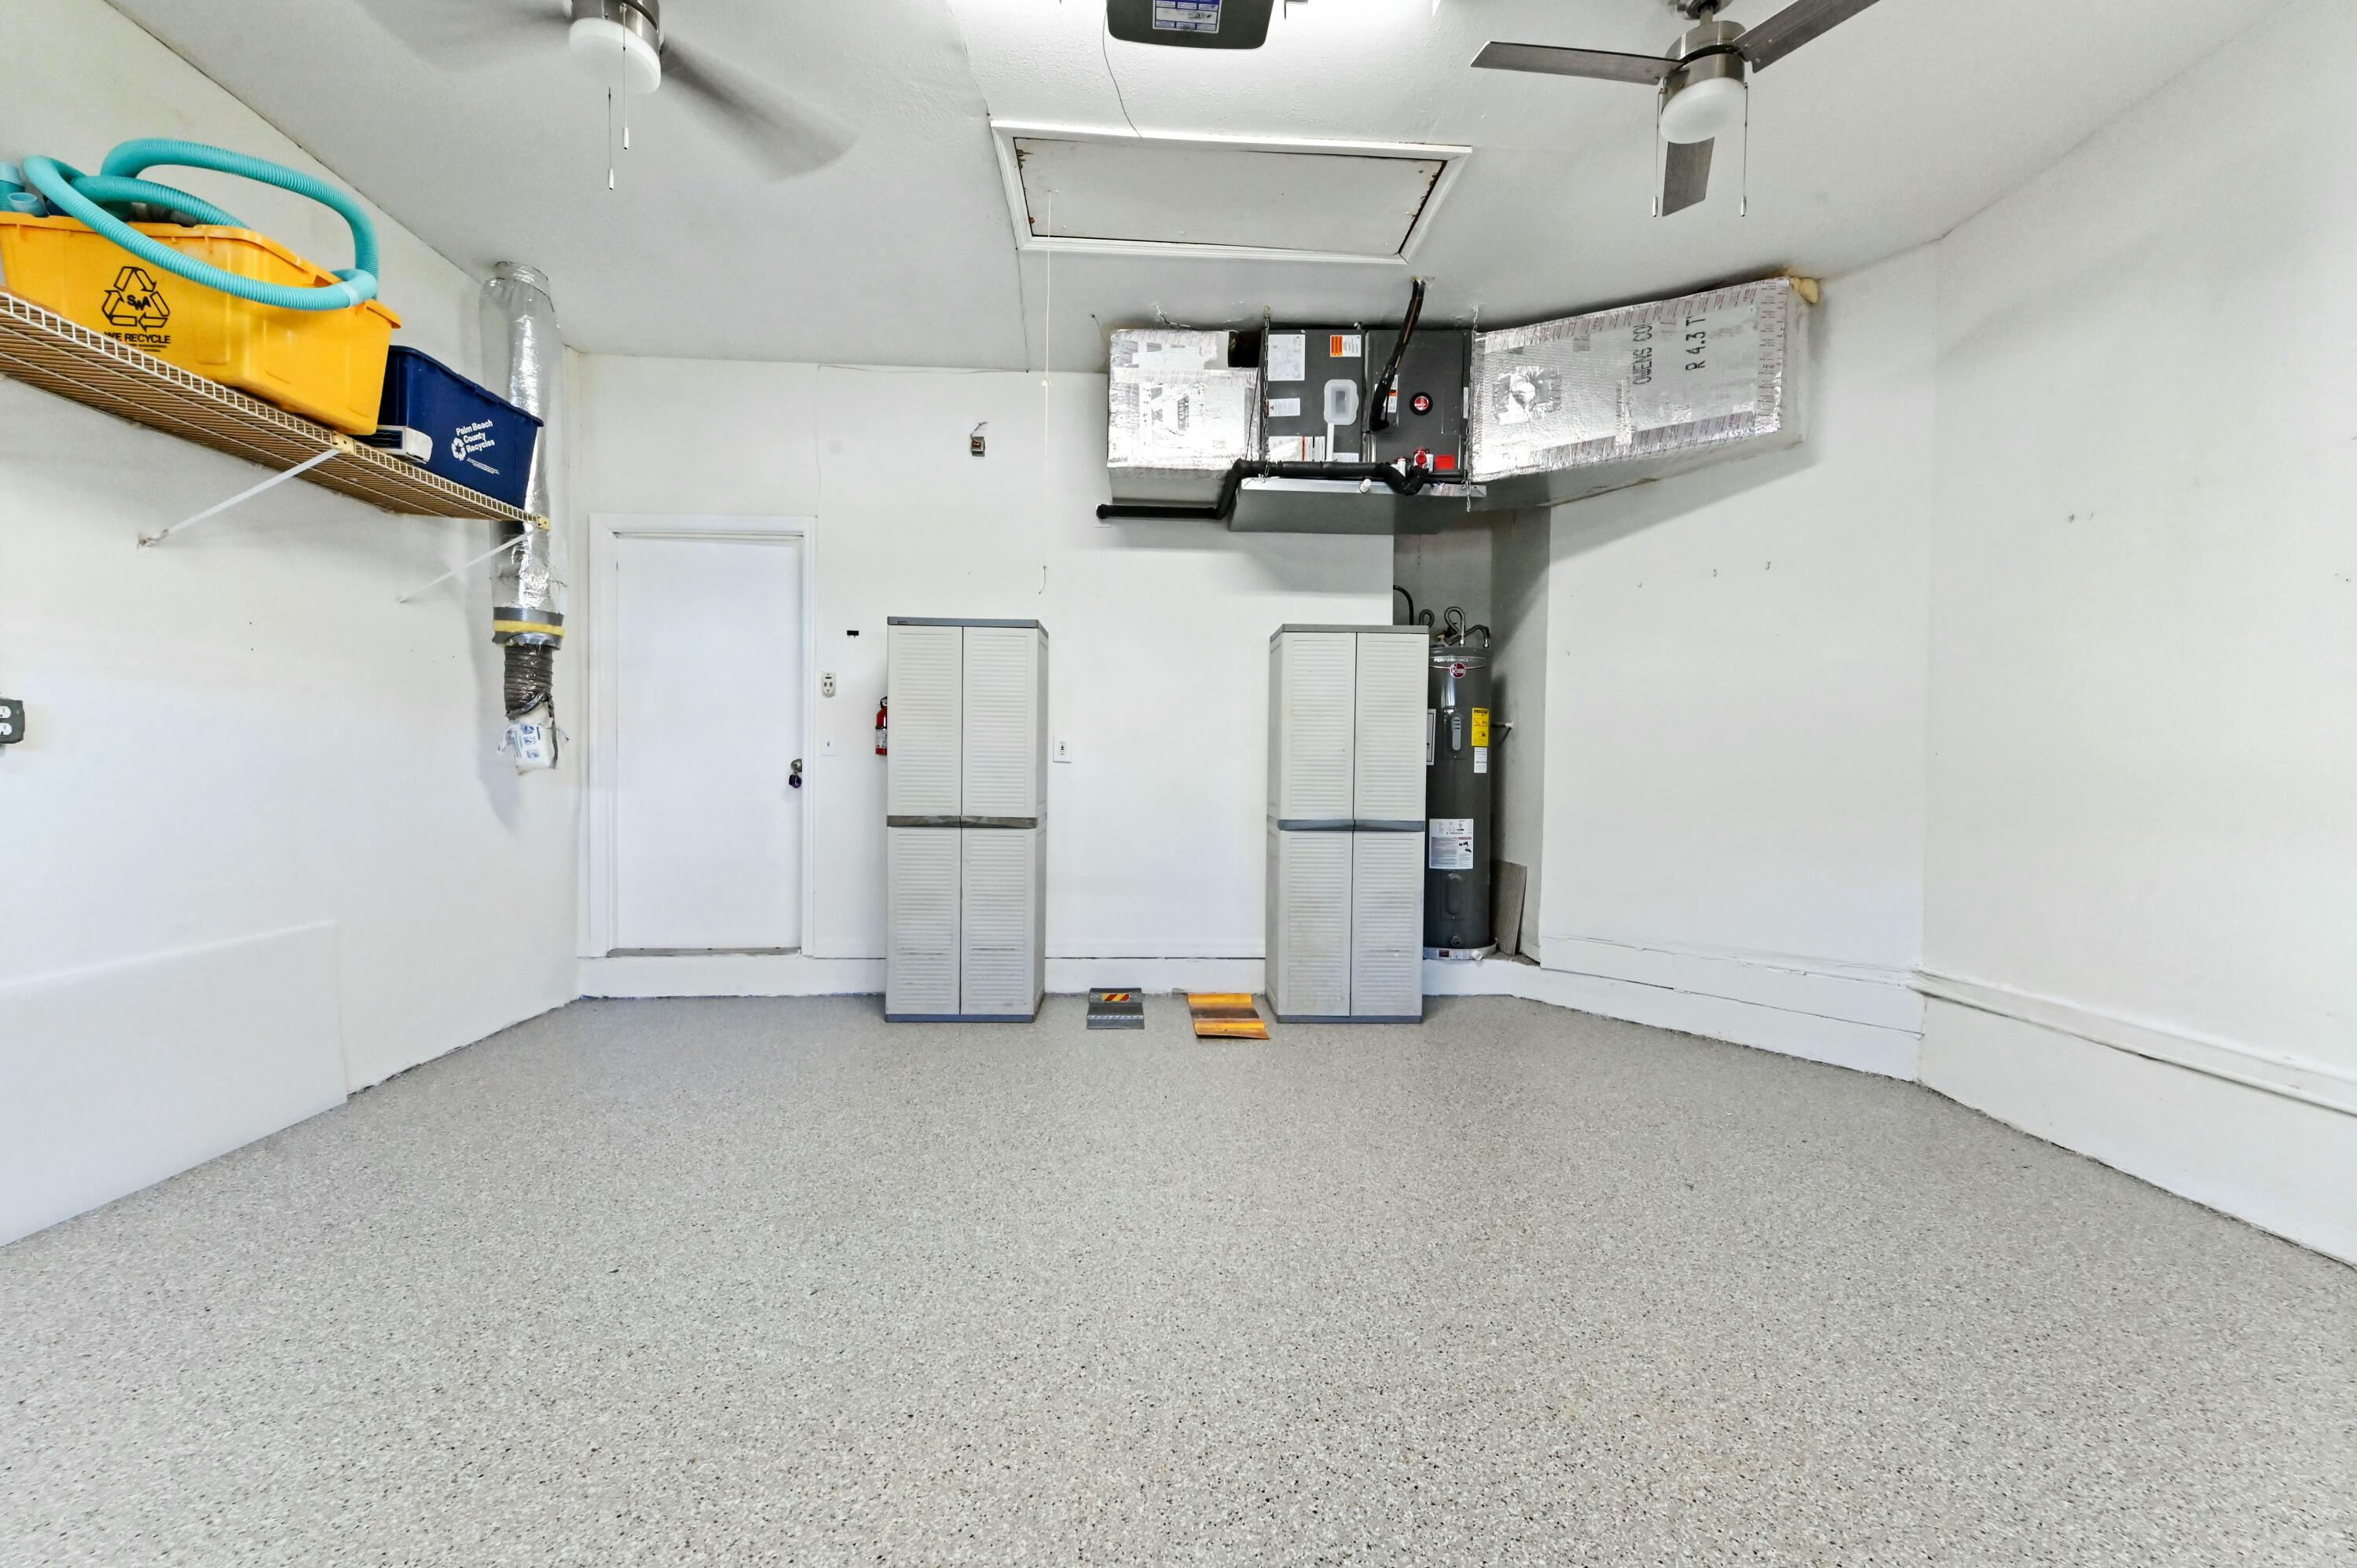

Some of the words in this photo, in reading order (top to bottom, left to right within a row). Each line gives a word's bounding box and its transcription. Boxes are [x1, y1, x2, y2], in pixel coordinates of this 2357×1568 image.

[126, 295, 152, 310] SWA
[124, 333, 170, 343] RECYCLE
[1685, 332, 1706, 354] 4.3
[1633, 347, 1652, 385] OWENS
[1685, 360, 1706, 371] R
[456, 426, 472, 436] Palm
[471, 419, 493, 431] Beach
[463, 431, 486, 443] County
[466, 440, 495, 452] Recycles
